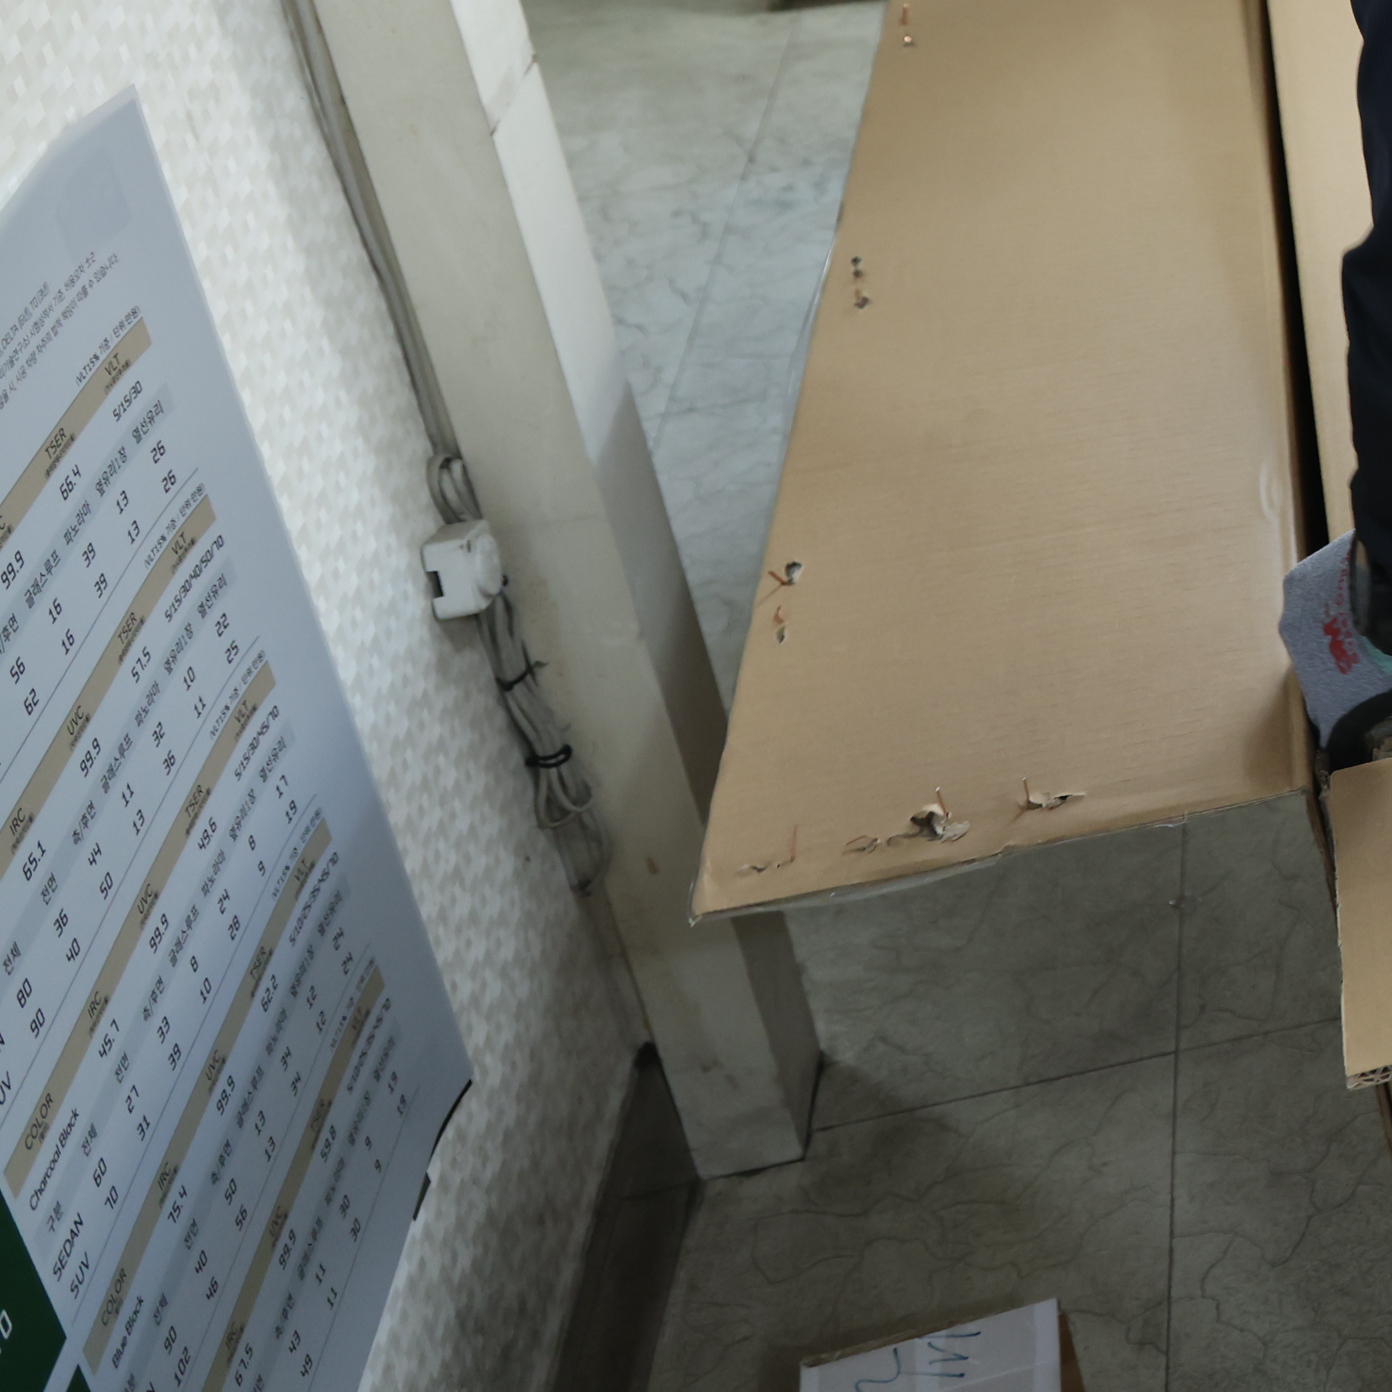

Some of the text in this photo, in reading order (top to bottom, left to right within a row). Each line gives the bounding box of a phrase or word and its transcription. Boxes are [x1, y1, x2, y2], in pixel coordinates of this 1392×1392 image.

[1, 551, 25, 590] 99.9
[60, 465, 82, 500] 66.4
[113, 381, 143, 422] 5/15/30
[45, 428, 68, 459] TSER
[105, 352, 120, 377] VLT
[63, 500, 91, 546] 파노라마
[131, 400, 164, 444] 열선유리
[9, 440, 166, 685] 56 16 39 13 26
[9, 807, 26, 837] IRC
[67, 705, 84, 736] UVC
[118, 612, 137, 645] TSER
[171, 533, 188, 557] VLT
[23, 469, 177, 716] 62 16 39 13 26
[2, 941, 22, 975] 전체
[40, 872, 59, 905] 전면
[134, 680, 161, 728] 파노라마
[16, 613, 231, 1009] 80 36 44 11 32 10 22
[22, 840, 47, 882] 65.1
[79, 737, 102, 778] 99.9
[131, 646, 152, 684] 57.5
[30, 640, 240, 1039] 90 40 50 13 36 11 25
[24, 1092, 53, 1151] COLOR
[88, 991, 103, 1019] IRC
[136, 883, 154, 915] UVC
[184, 784, 203, 817] TSER
[29, 1149, 62, 1211] Charcoal
[60, 1108, 80, 1150] Black
[98, 1018, 120, 1058] 45.7
[149, 913, 170, 954] 99.9
[198, 816, 218, 851] 49.6
[52, 774, 289, 1283] SEDAN 60 27 33 8 24 8 17
[69, 799, 298, 1300] SUV 70 31 39 10 28 9 19
[81, 1123, 98, 1157] 전체
[114, 1051, 130, 1084] 전면
[101, 1268, 128, 1327] COLOR
[157, 1162, 172, 1190] IRC
[111, 1335, 128, 1370] Blue
[124, 1295, 145, 1336] Black
[167, 1185, 188, 1224] 75.4
[216, 1075, 236, 1116] 99.9
[261, 974, 278, 1013] 62.2
[163, 927, 344, 1355] 90 40 50 13 34 12 24
[173, 951, 354, 1388] 102 46 56 13 34 12 24
[288, 1329, 301, 1354] 43
[315, 1263, 327, 1286] 11
[339, 1194, 350, 1219] 30
[388, 1071, 399, 1095] 19
[234, 1342, 253, 1388] 67.5
[278, 1229, 297, 1271] 99.9
[300, 1353, 313, 1378] 49
[326, 1286, 338, 1311] 11
[350, 1217, 362, 1243] 30
